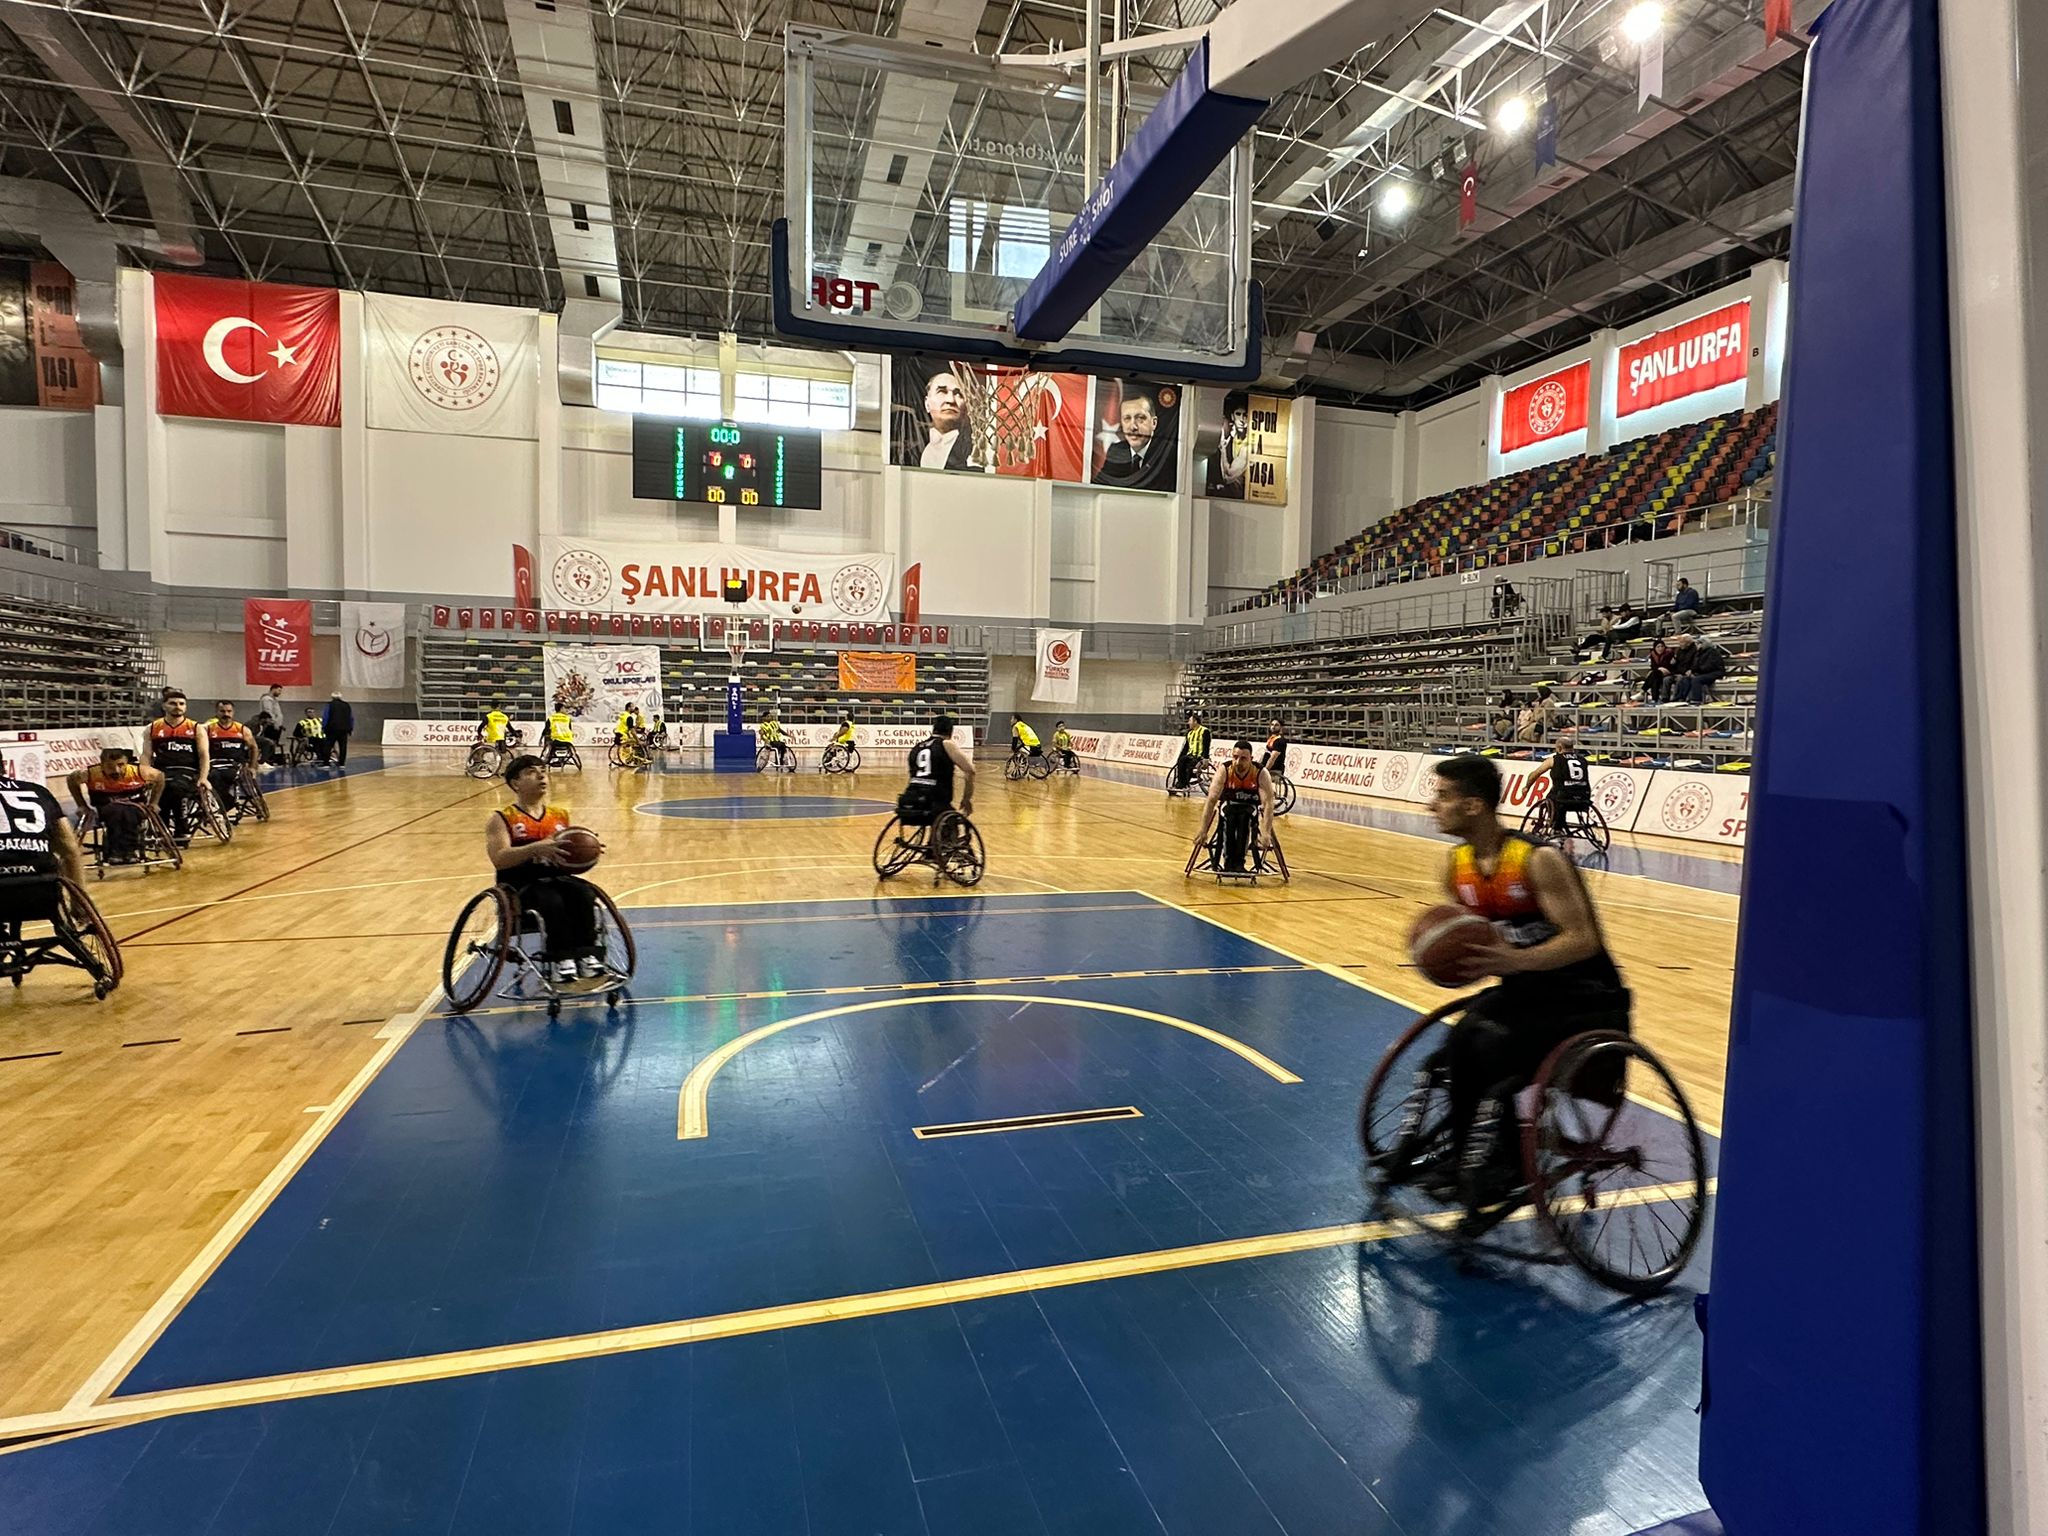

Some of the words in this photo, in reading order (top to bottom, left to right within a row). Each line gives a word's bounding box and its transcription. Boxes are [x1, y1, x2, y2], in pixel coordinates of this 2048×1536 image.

[1060, 228, 1078, 264] SURE
[1092, 181, 1115, 222] SHOT
[1629, 322, 1742, 397] ŞANLIURFA
[1752, 347, 1760, 358] B
[41, 356, 79, 391] YAŞA
[1251, 410, 1278, 433] SPOR
[1249, 461, 1275, 487] YAŞA
[708, 489, 726, 503] 00
[741, 492, 759, 505] 00
[258, 648, 299, 662] THF
[447, 724, 478, 735] GENÇL
[893, 728, 928, 739] GENÇLİK
[424, 734, 450, 742] SPOR
[875, 738, 897, 746] SPOR
[916, 748, 932, 777] 9
[1310, 752, 1324, 764] T.C.
[1325, 752, 1365, 770] GENÇLİK
[1365, 757, 1378, 770] VE
[1301, 768, 1326, 781] SPOR
[1325, 770, 1375, 787] BAKANLIĞI
[1567, 759, 1583, 780] 6
[0, 865, 36, 875] XTRA
